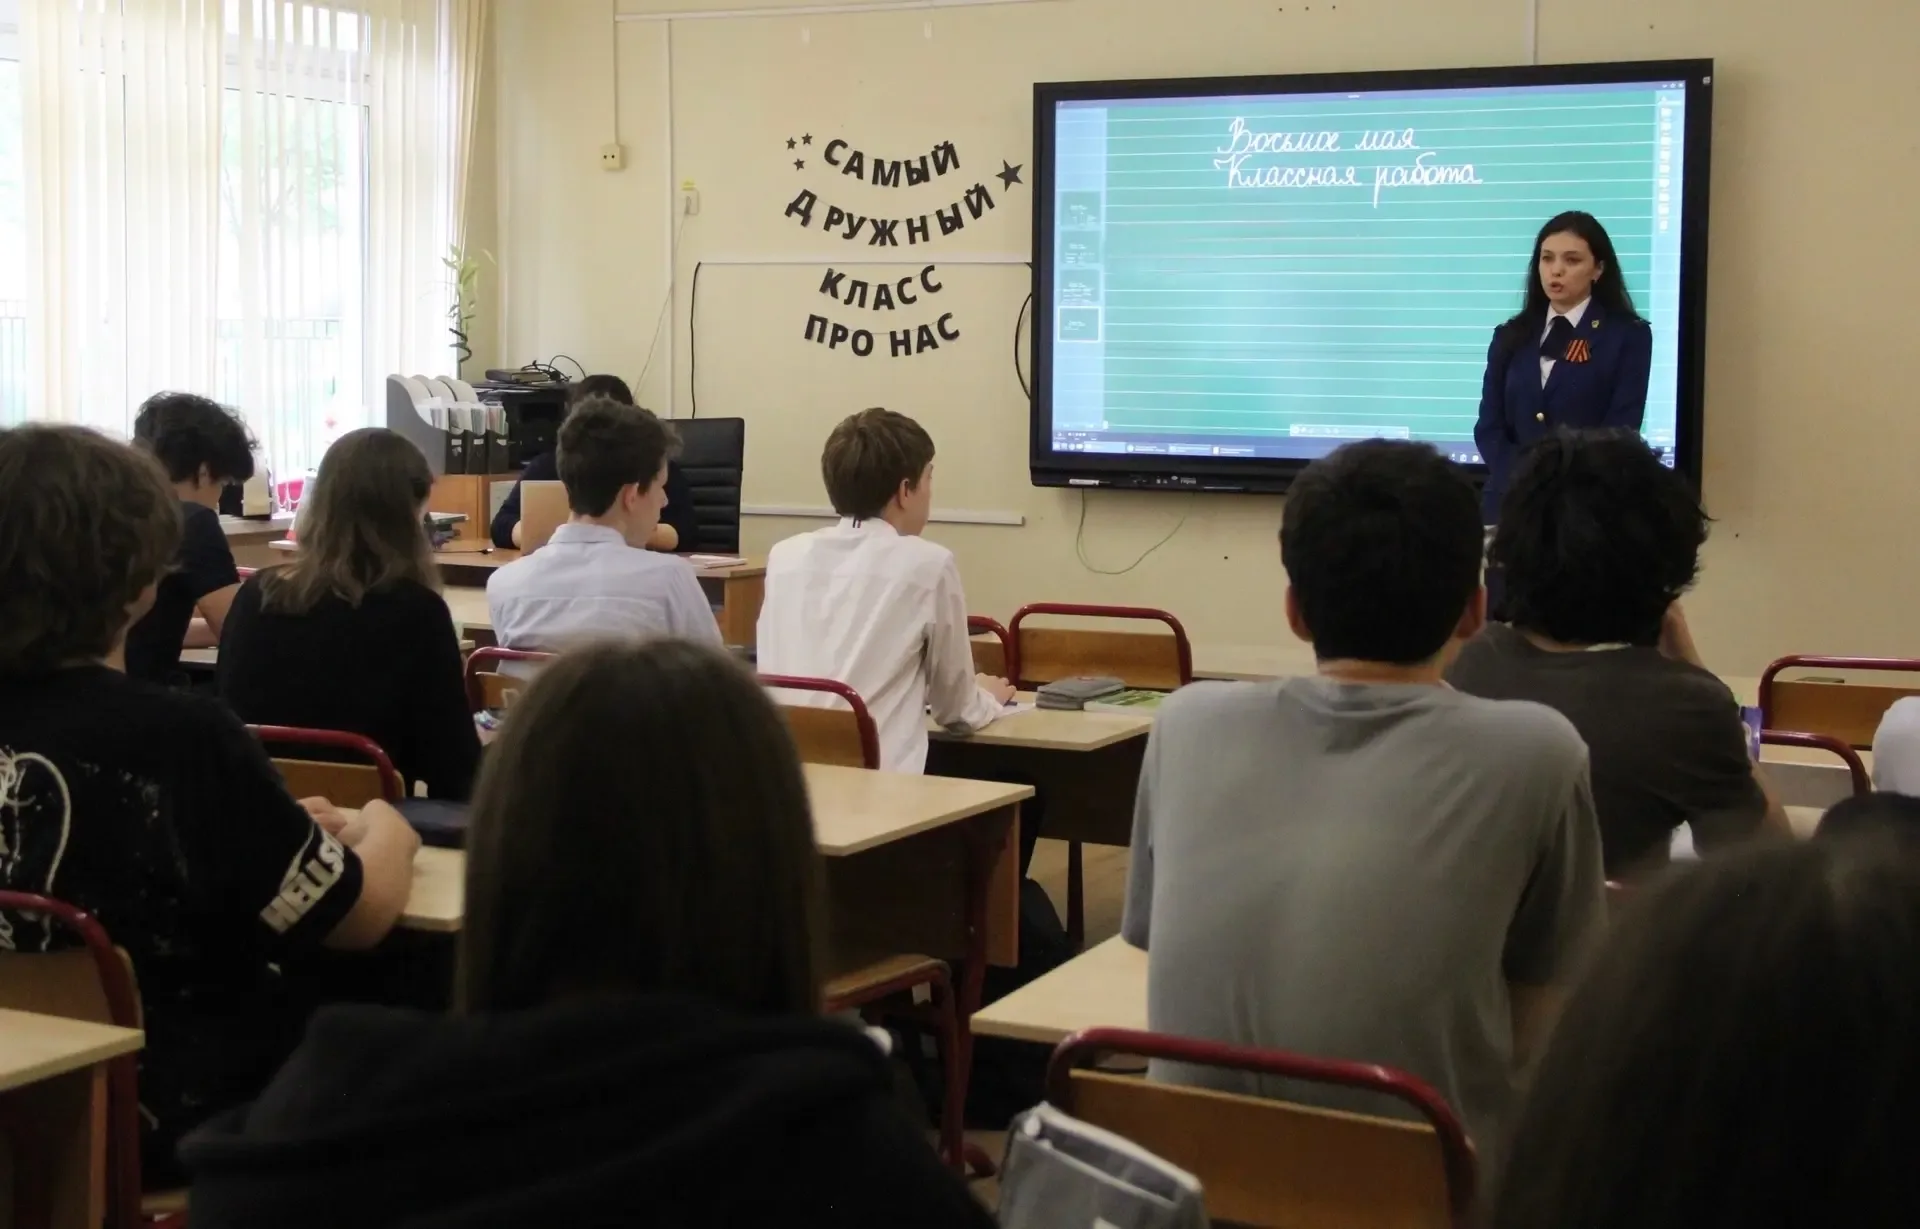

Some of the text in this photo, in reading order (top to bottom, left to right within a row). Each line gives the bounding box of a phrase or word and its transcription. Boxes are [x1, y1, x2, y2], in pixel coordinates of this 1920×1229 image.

[1217, 116, 1420, 154] Восьмое мая
[824, 139, 960, 188] САМЫЙ
[1213, 152, 1483, 209] Классная работа
[784, 183, 995, 246] ДРУЖНЫЙ
[819, 264, 942, 310] КЛАСС
[804, 313, 960, 357] ПРО НАС
